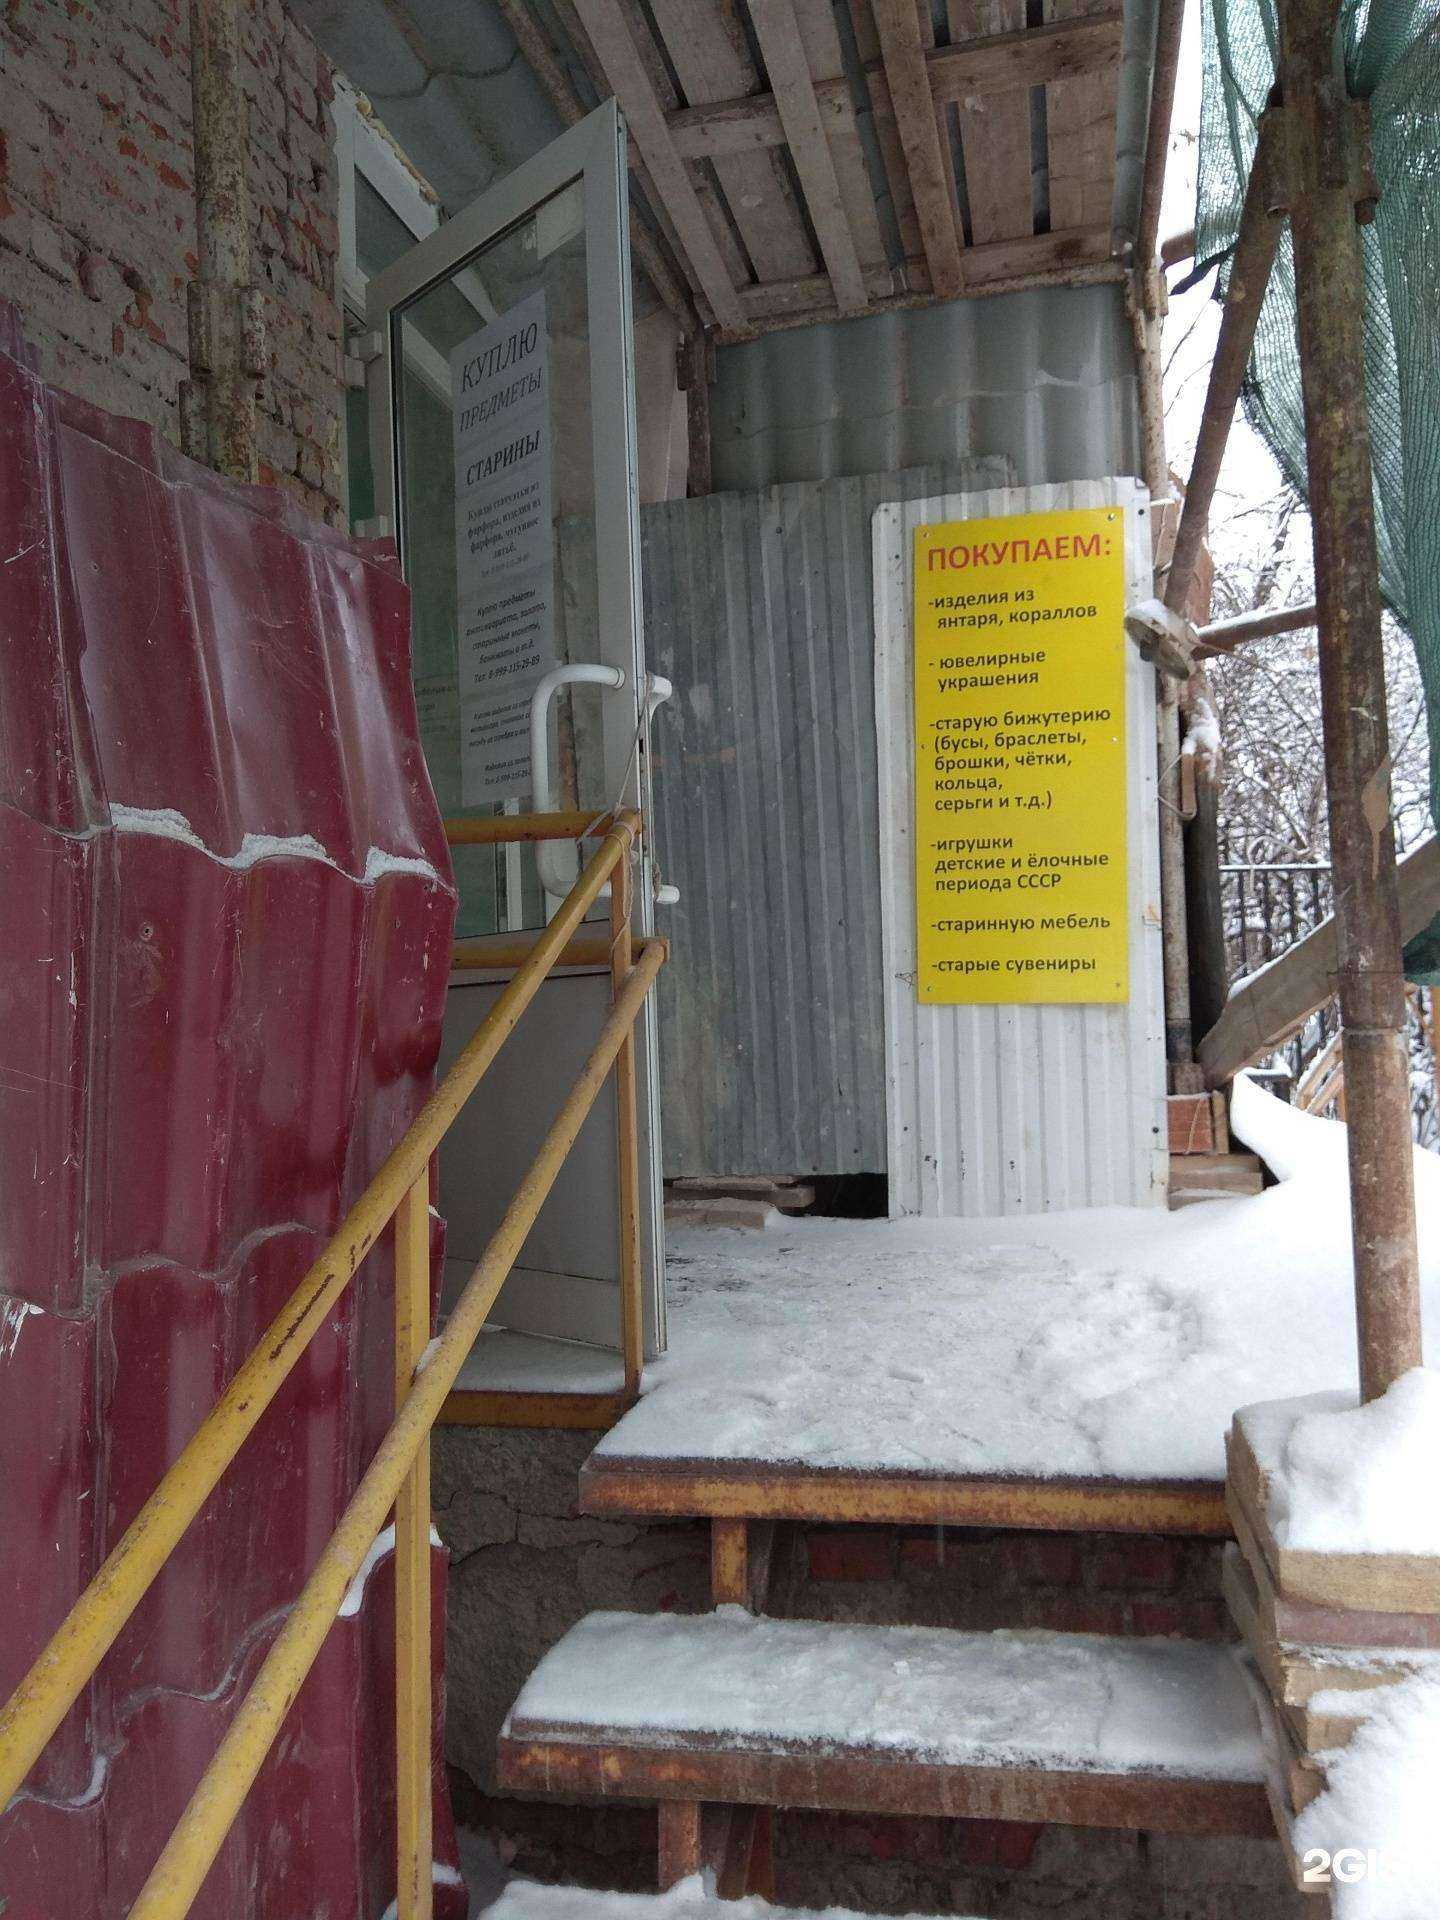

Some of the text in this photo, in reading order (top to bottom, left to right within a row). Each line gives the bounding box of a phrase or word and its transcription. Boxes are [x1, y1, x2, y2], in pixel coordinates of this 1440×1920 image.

[462, 322, 538, 393] КУПЛЮ
[460, 367, 542, 432] ПРЕДМЕТЫ
[465, 430, 540, 486] СТАРИНЫ
[928, 533, 1111, 571] ПОКУПАЕМ:
[928, 589, 1034, 610] -изделия из
[938, 604, 1098, 629] янтаря, кораллов
[940, 649, 1046, 669] ювелирные
[938, 671, 1039, 692] украшения
[929, 709, 1111, 732] -старую бижутерию
[934, 731, 1087, 753] (бусы, браслеты,
[934, 751, 1072, 772] брошки, чётки,
[935, 776, 1003, 791] кольца,
[934, 790, 1052, 812] серьги и т.д.)
[930, 837, 1013, 853] -игрушки
[934, 850, 1109, 874] детские и ёлочные
[935, 874, 1061, 893] периода СССР
[931, 913, 1111, 933] -старинную мебель
[932, 958, 1096, 974] -старые сувениры
